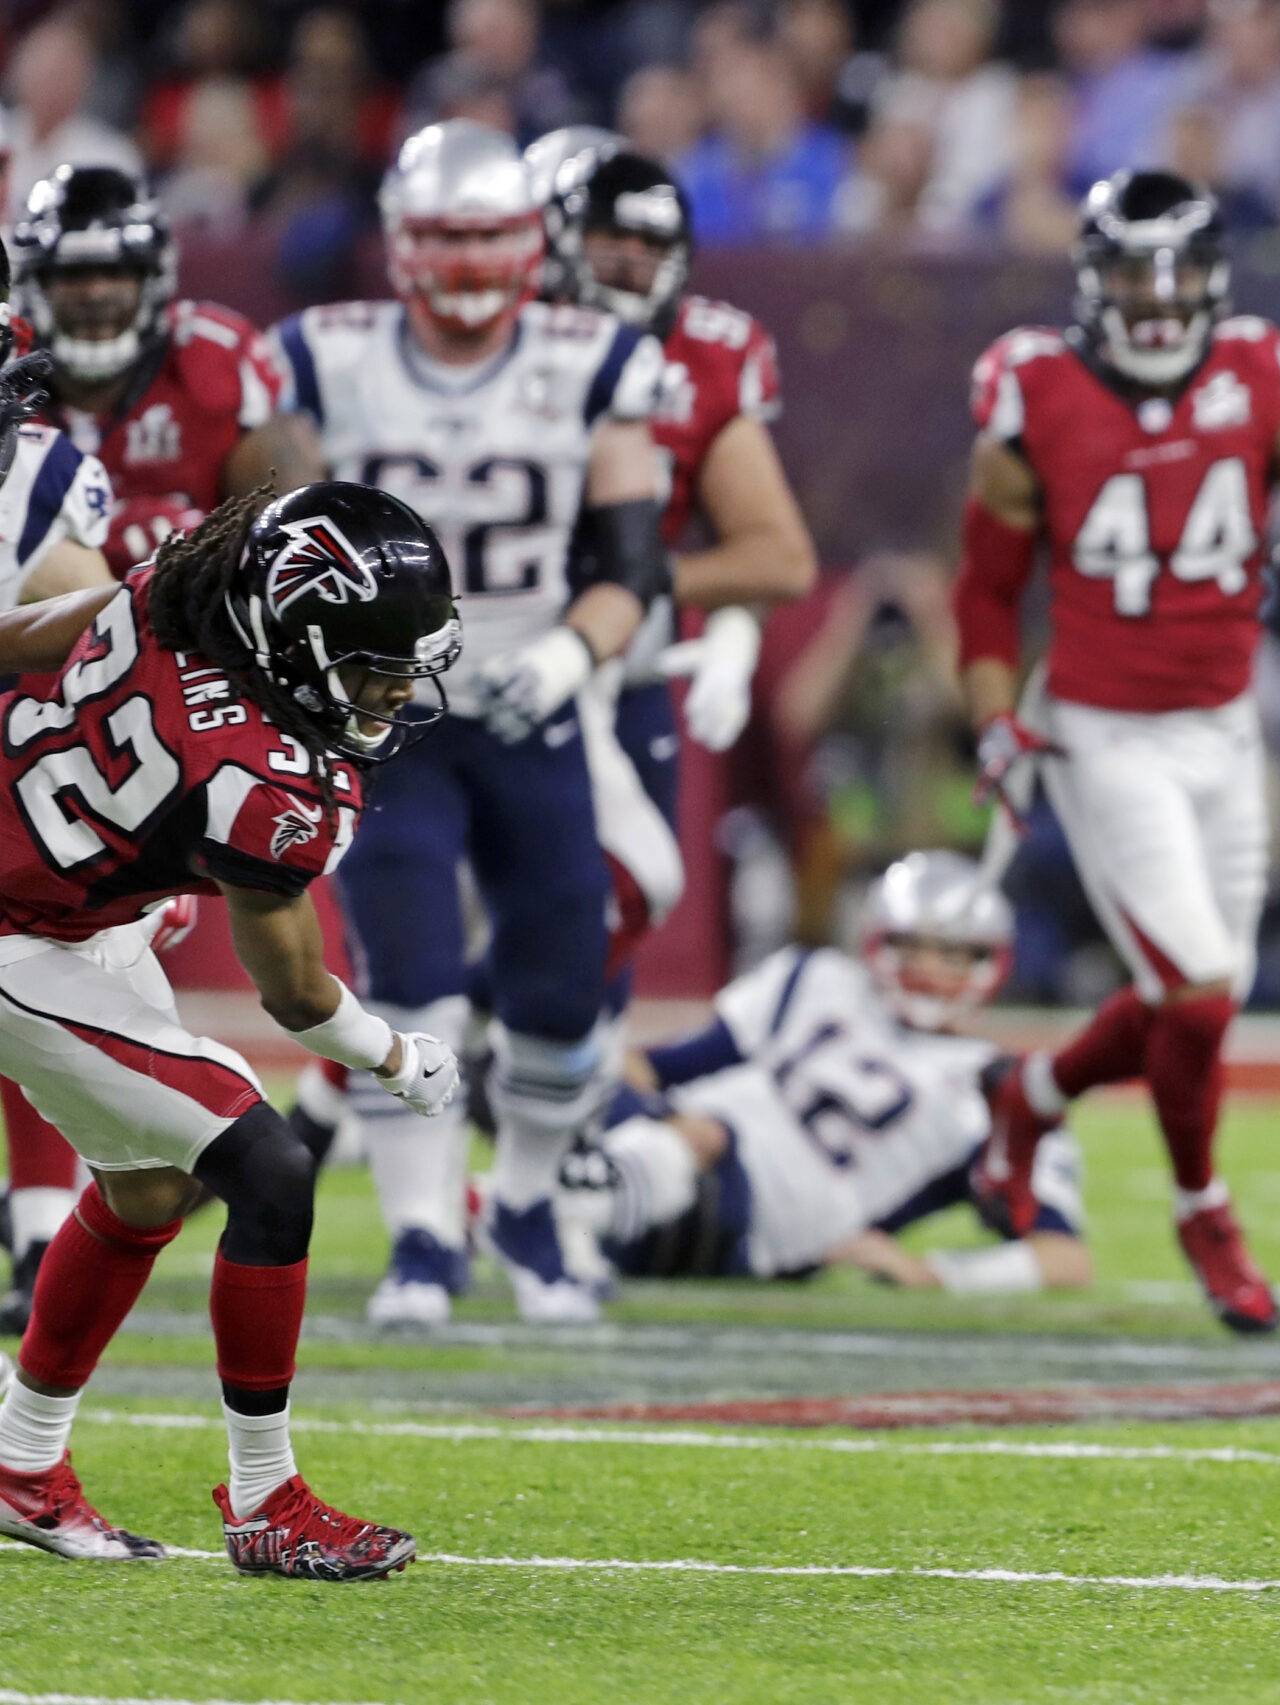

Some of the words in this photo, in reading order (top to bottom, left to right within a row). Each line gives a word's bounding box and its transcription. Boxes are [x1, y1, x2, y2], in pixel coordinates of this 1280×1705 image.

[1072, 456, 1258, 617] 44
[4, 584, 184, 876] 32
[768, 1016, 917, 1174] 12
